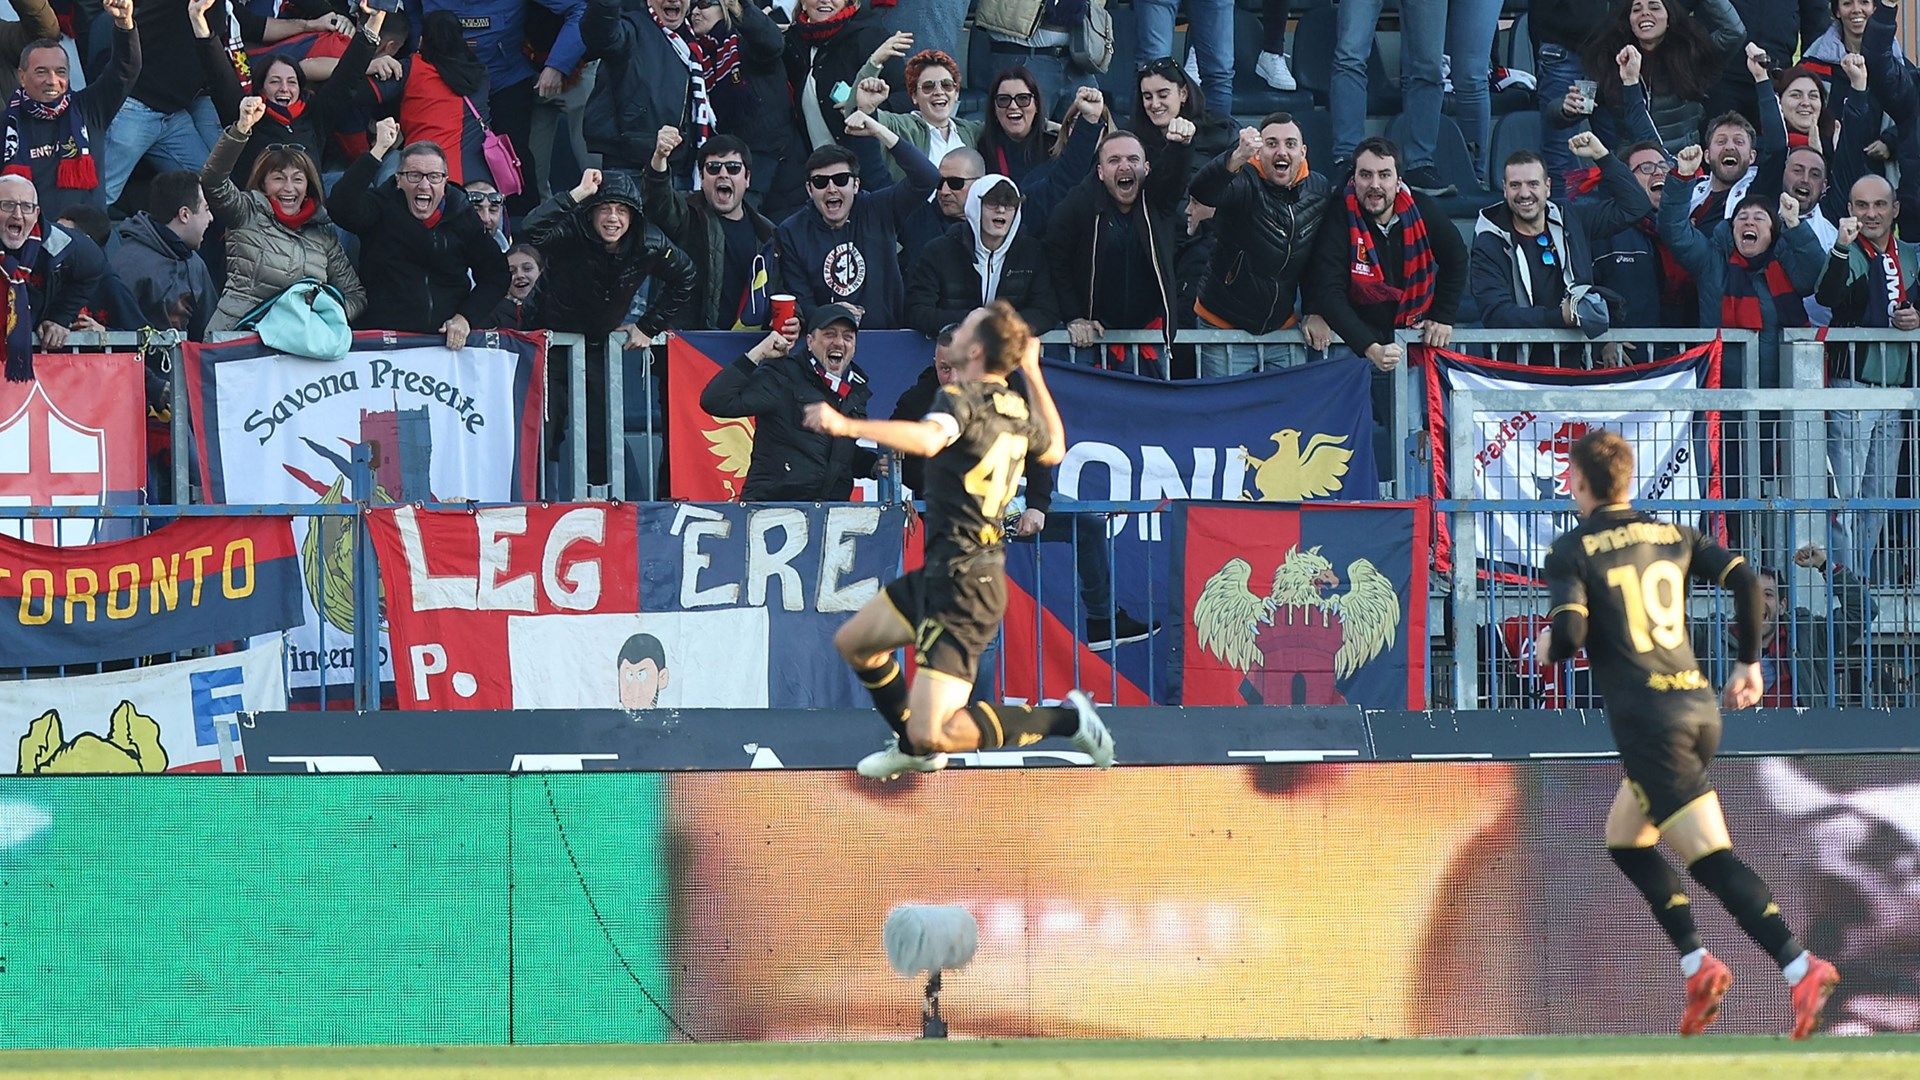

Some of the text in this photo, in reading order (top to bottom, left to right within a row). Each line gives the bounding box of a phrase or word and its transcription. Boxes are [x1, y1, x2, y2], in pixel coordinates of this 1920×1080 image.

[243, 359, 485, 446] Savona Presente
[0, 537, 256, 626] ORONTO
[1606, 559, 1685, 654] 19
[410, 643, 478, 701] P.
